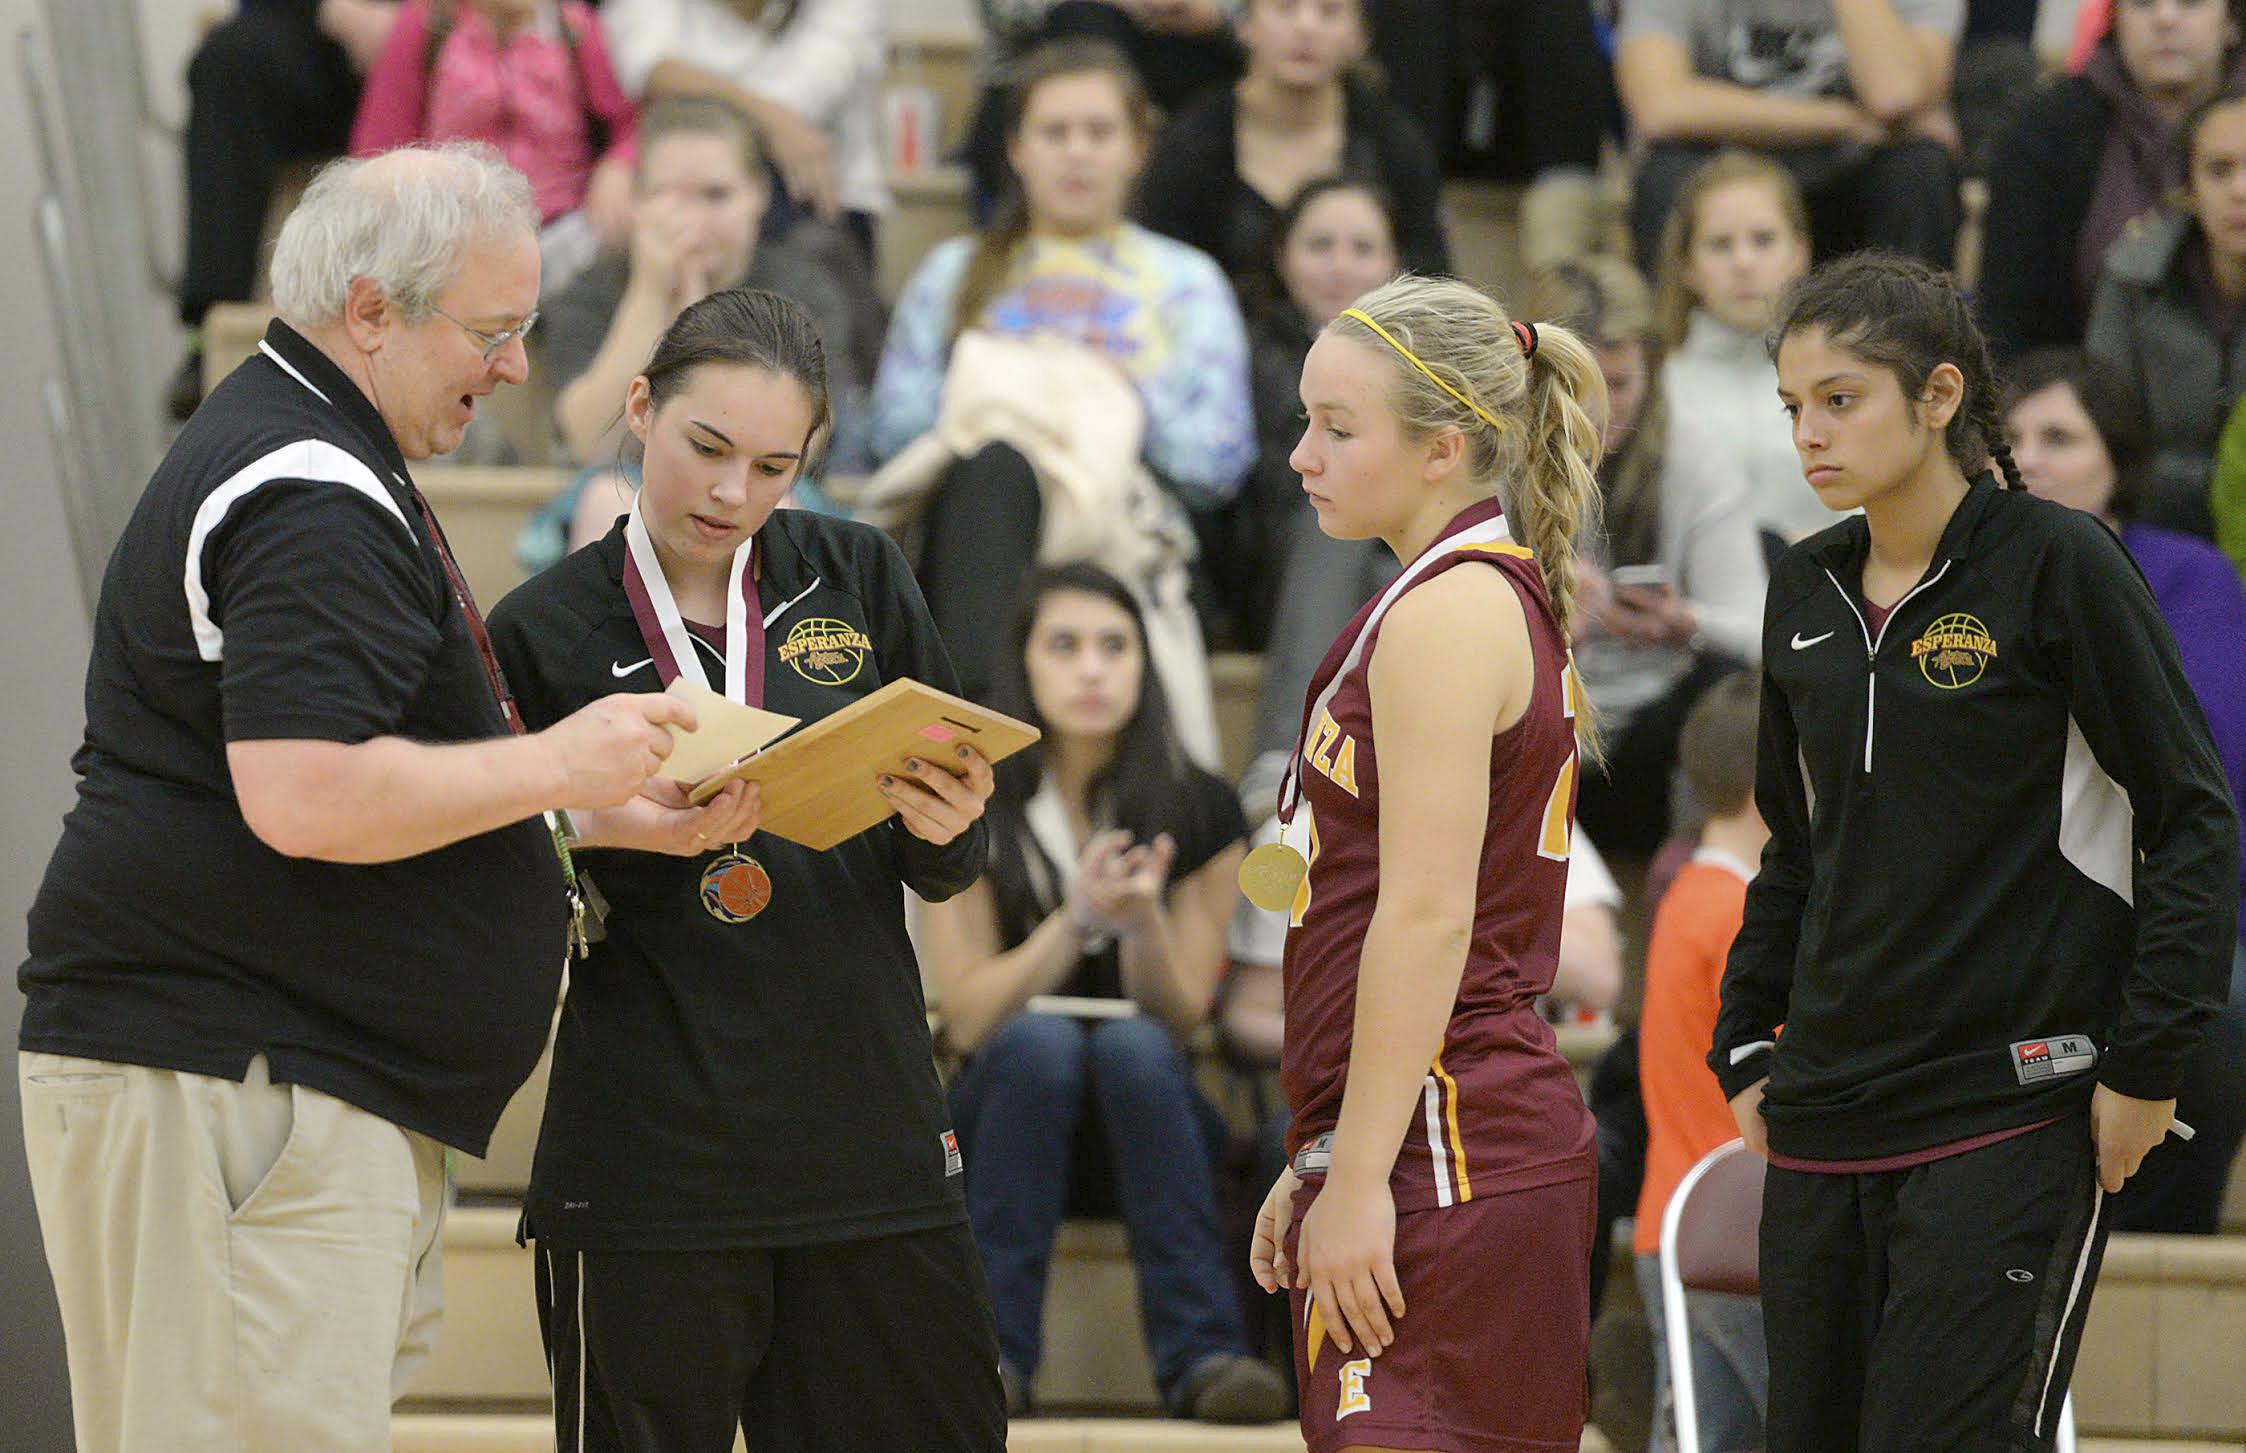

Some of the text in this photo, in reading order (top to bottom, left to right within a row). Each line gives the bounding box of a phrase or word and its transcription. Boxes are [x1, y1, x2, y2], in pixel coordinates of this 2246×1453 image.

[777, 632, 873, 663] ESPERANZA
[1910, 632, 1998, 658] ESPERANZA
[2024, 1055, 2048, 1064] TEAM
[2061, 1041, 2078, 1054] M
[1336, 1358, 1372, 1422] E
